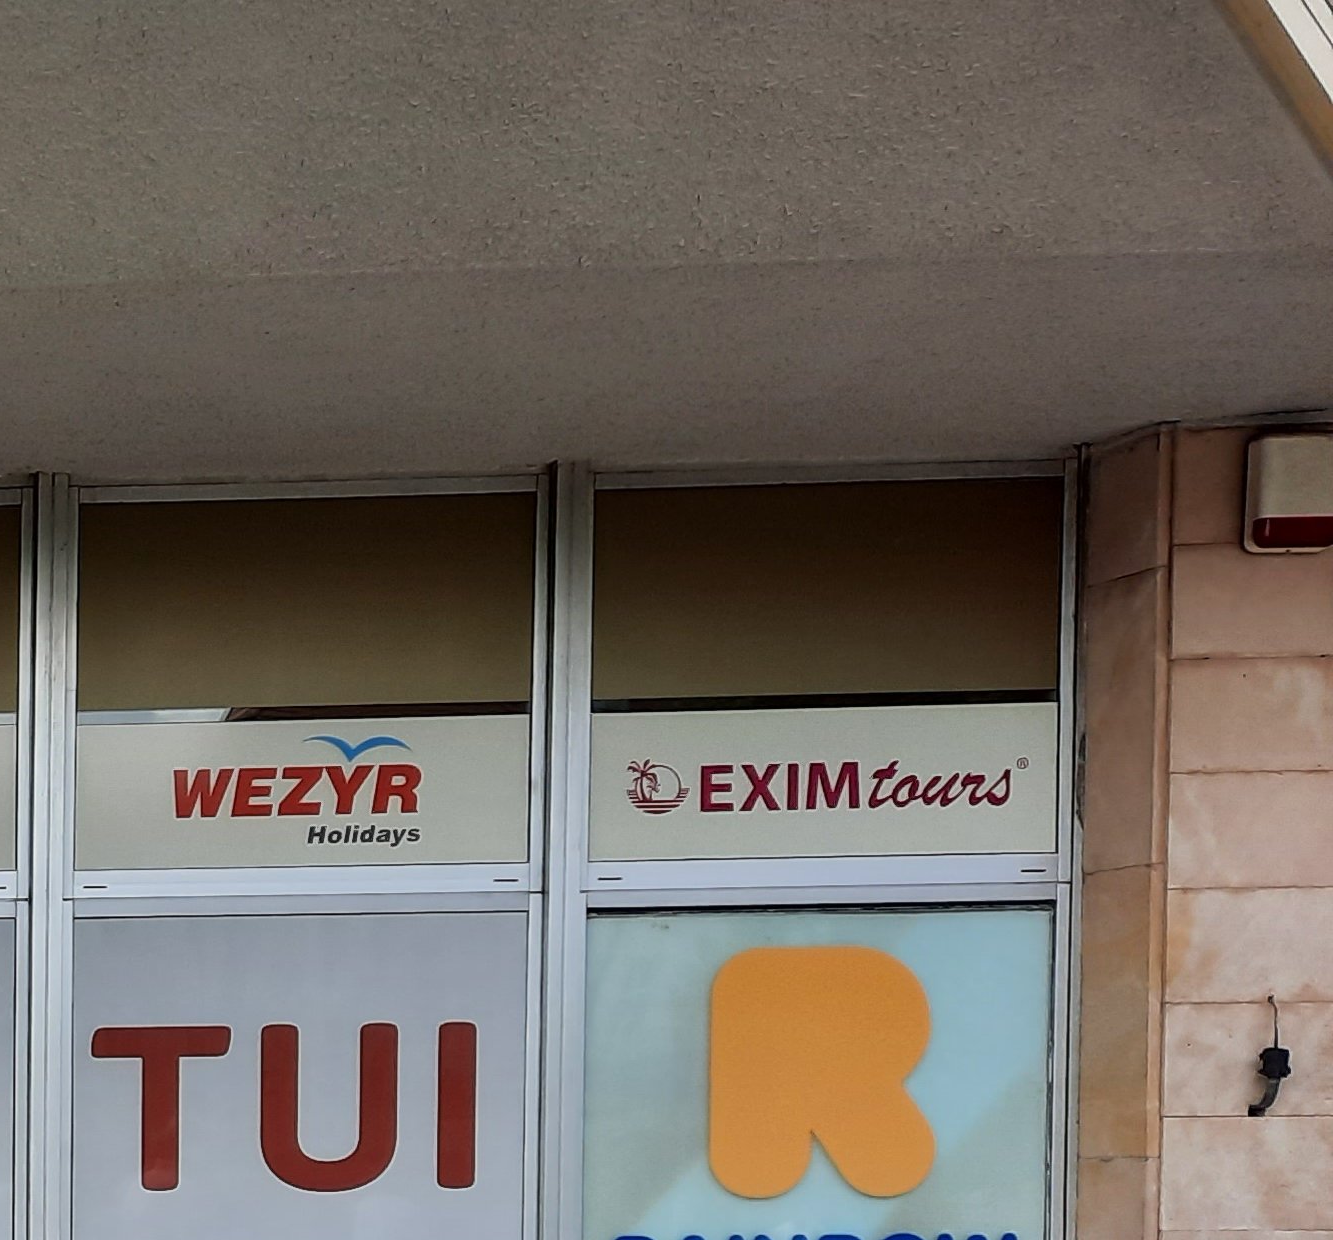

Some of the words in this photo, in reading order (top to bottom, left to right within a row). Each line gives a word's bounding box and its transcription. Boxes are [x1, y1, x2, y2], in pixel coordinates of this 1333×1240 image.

[172, 763, 423, 820] WEZYR
[306, 824, 422, 848] Holidays
[90, 1021, 478, 1193] TUI
[709, 945, 936, 1199] R
